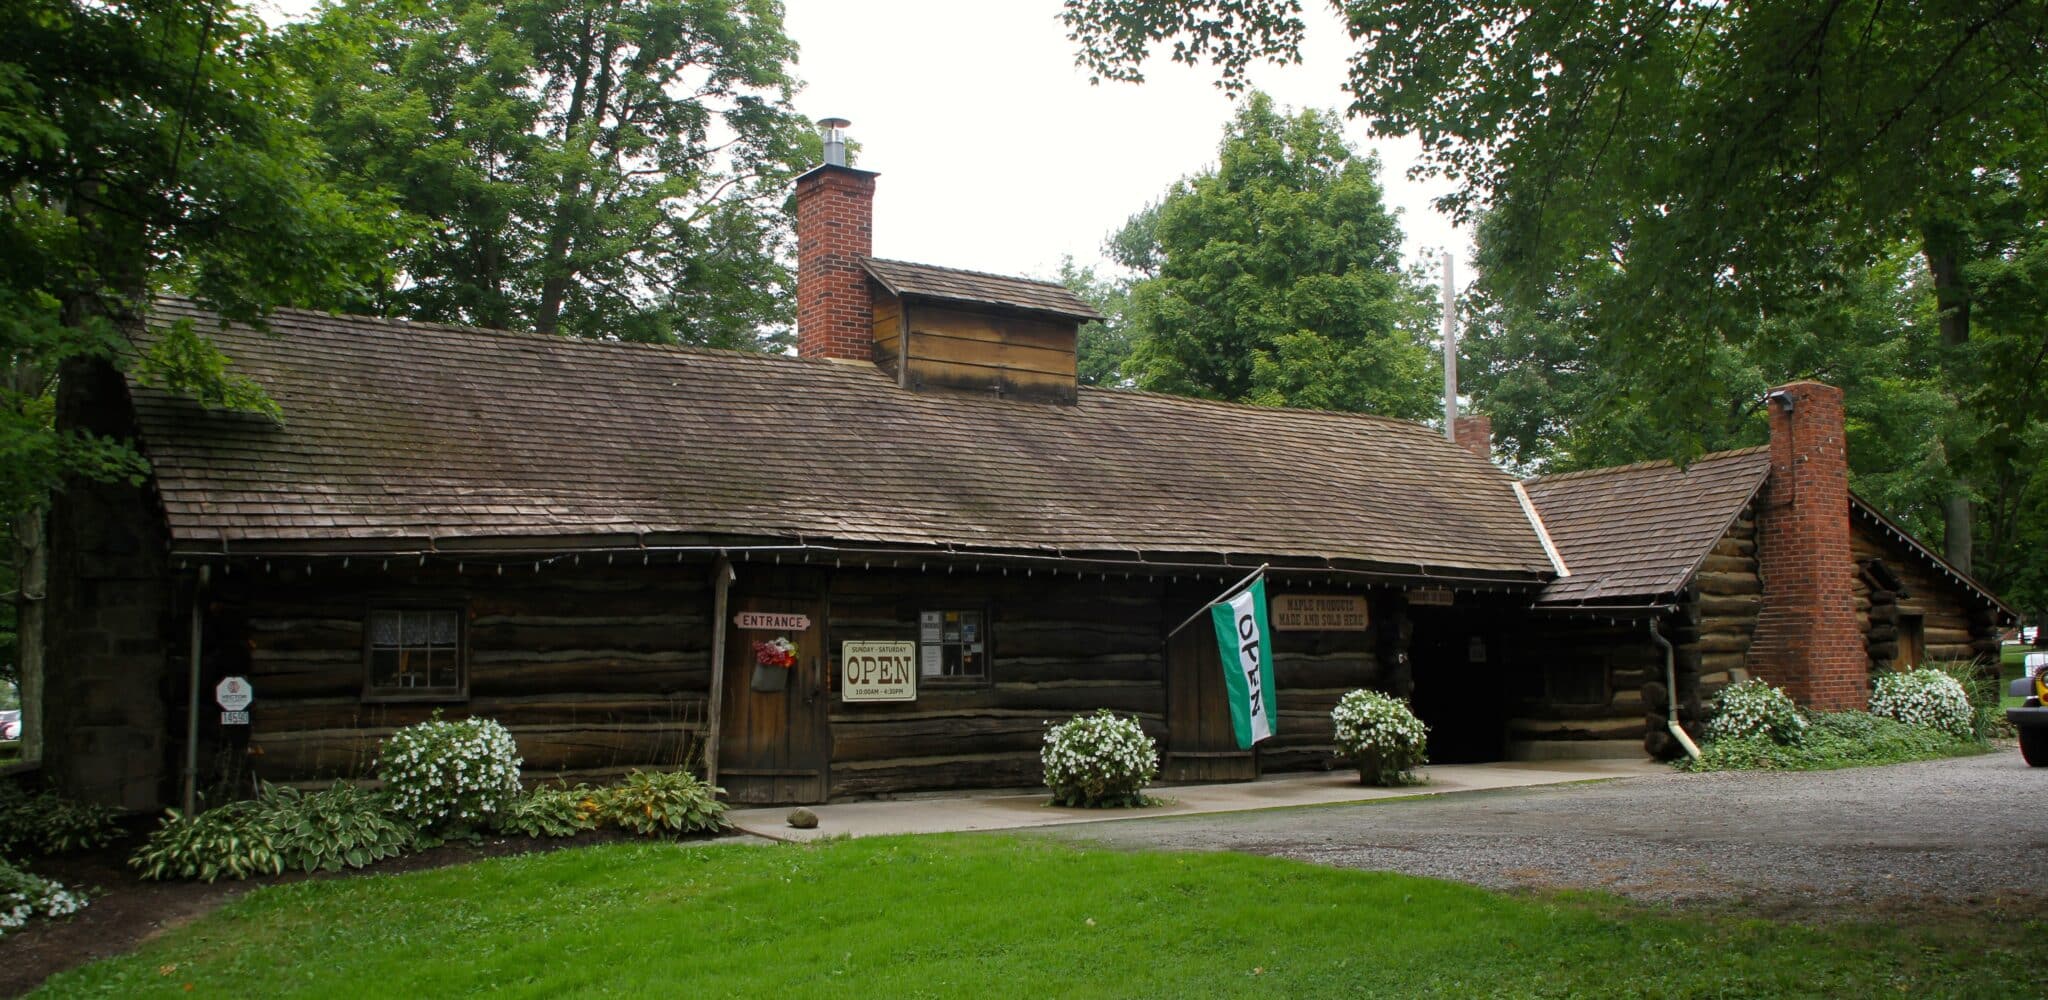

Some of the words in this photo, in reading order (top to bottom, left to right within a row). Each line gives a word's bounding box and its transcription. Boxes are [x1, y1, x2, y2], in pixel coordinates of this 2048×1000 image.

[1287, 600, 1313, 610] MAPLE
[1316, 600, 1354, 611] PRODUCTS
[743, 615, 803, 628] ENTRANCE
[1279, 613, 1300, 625] MADE
[1303, 614, 1319, 625] AND
[1321, 614, 1341, 625] SOLD
[1343, 614, 1363, 625] HERE
[847, 656, 911, 685] OPEN
[1239, 614, 1261, 717] OPEN
